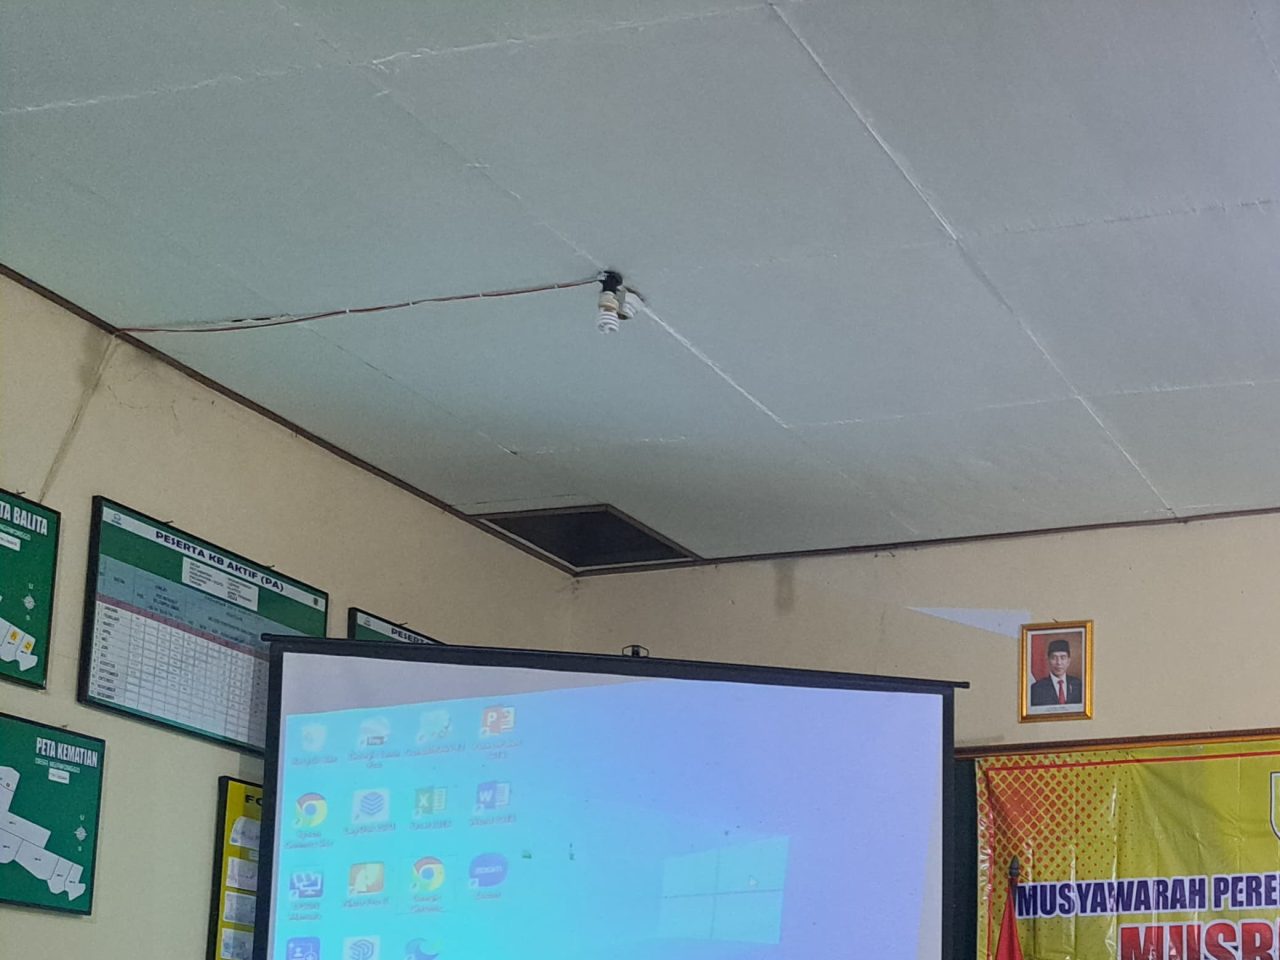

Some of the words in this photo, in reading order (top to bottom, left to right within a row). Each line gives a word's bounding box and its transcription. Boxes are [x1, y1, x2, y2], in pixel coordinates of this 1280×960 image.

[13, 505, 48, 535] BALITA
[155, 530, 205, 559] PESERTA
[209, 553, 224, 566] KB
[227, 561, 258, 580] AKTIF
[261, 575, 284, 592] (PA)
[36, 737, 56, 758] PETA
[58, 742, 98, 768] KEMATIAN
[1017, 877, 1206, 917] MUSYAWARAH
